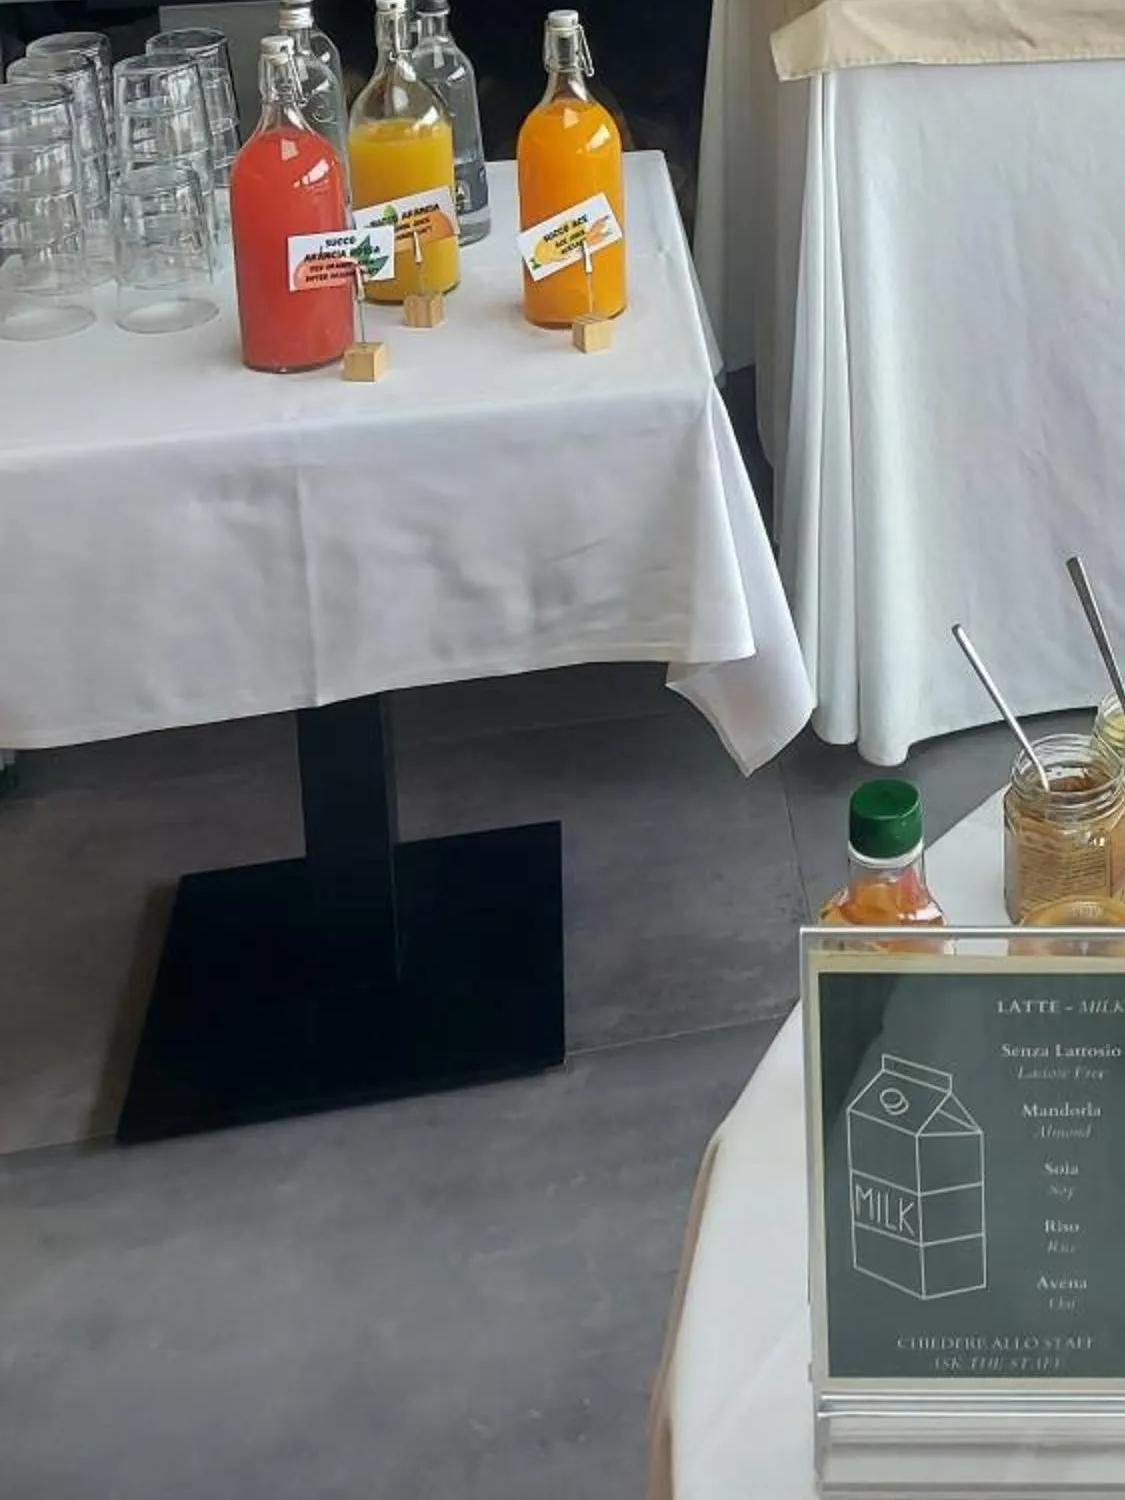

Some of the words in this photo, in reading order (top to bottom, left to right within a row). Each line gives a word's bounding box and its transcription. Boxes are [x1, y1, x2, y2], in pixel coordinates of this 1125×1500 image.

[997, 999, 1062, 1014] LATTE
[1000, 1043, 1050, 1058] Senza
[1022, 1102, 1102, 1118] Mandorla
[853, 1183, 917, 1238] MILK
[1036, 1274, 1088, 1290] Avena
